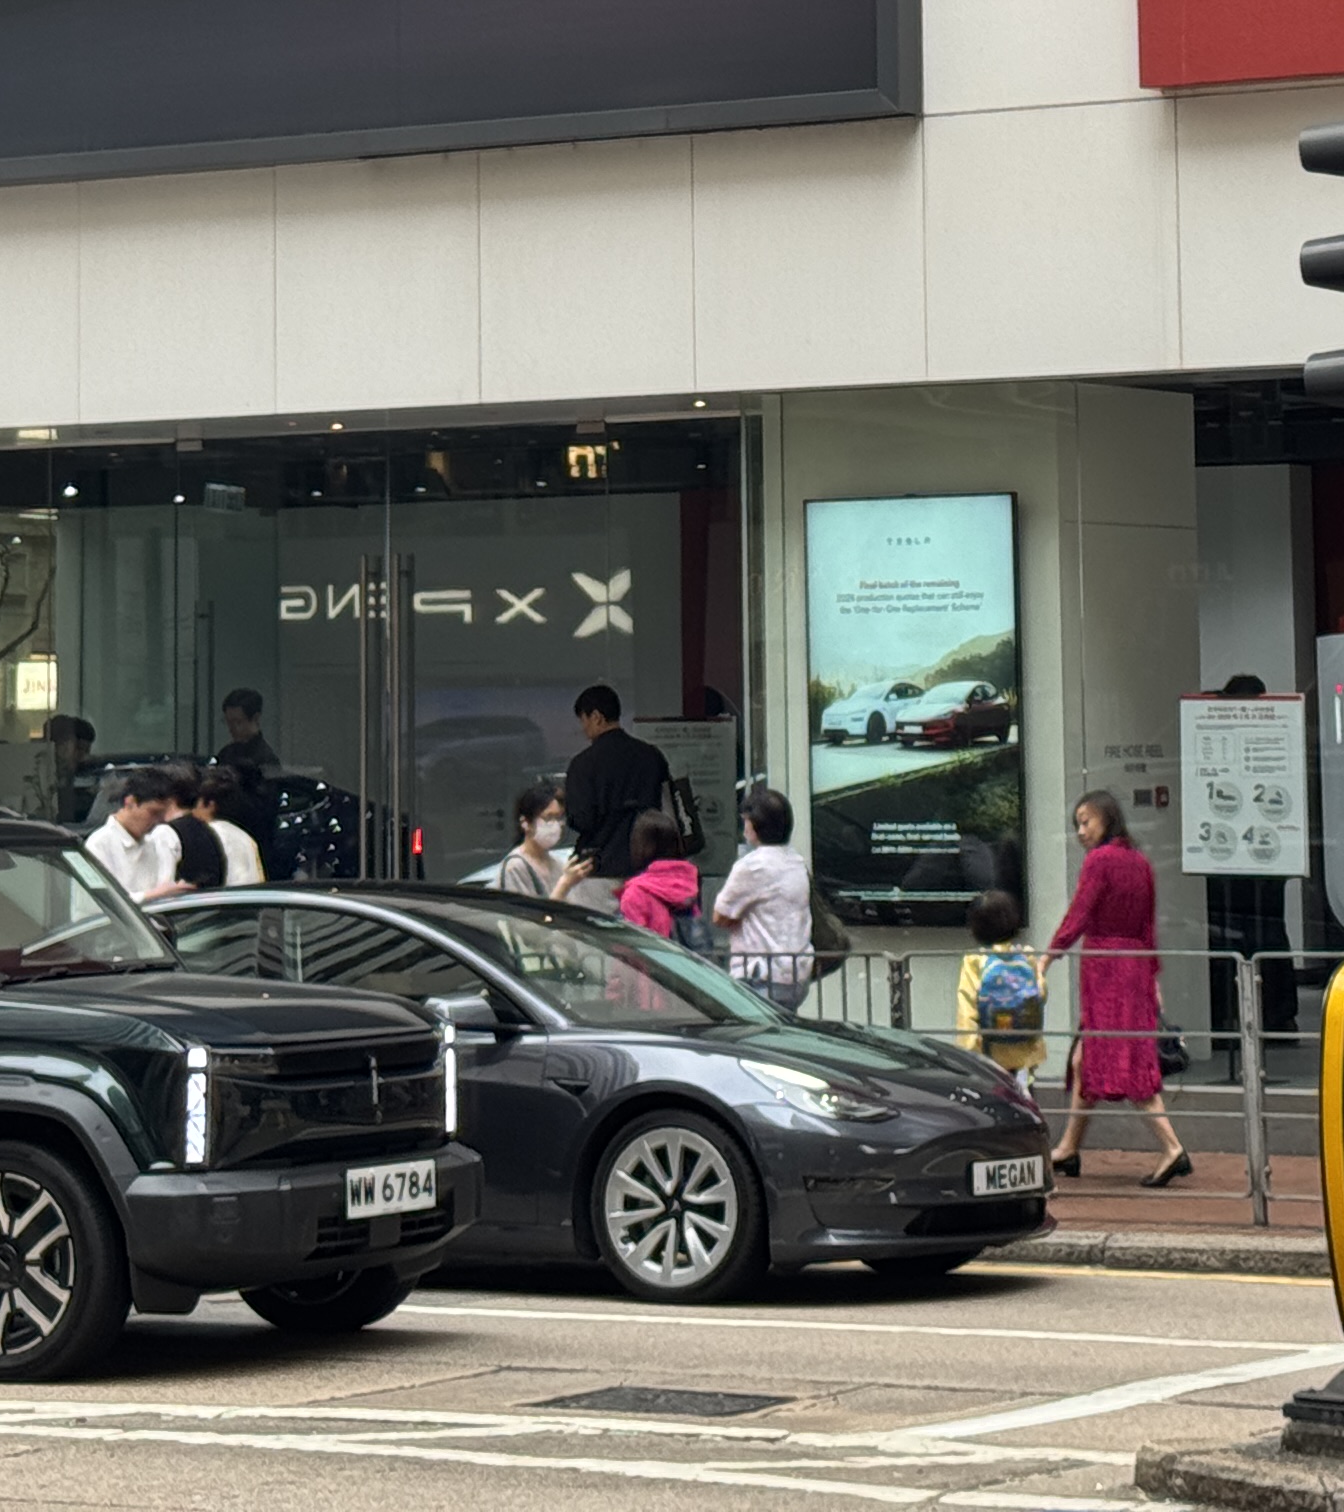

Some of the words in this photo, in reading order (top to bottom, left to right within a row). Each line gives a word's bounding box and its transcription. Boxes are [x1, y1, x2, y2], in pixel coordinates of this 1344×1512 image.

[350, 1173, 376, 1207] WW
[382, 1169, 433, 1203] 6784
[985, 1159, 1036, 1190] MEGAN
